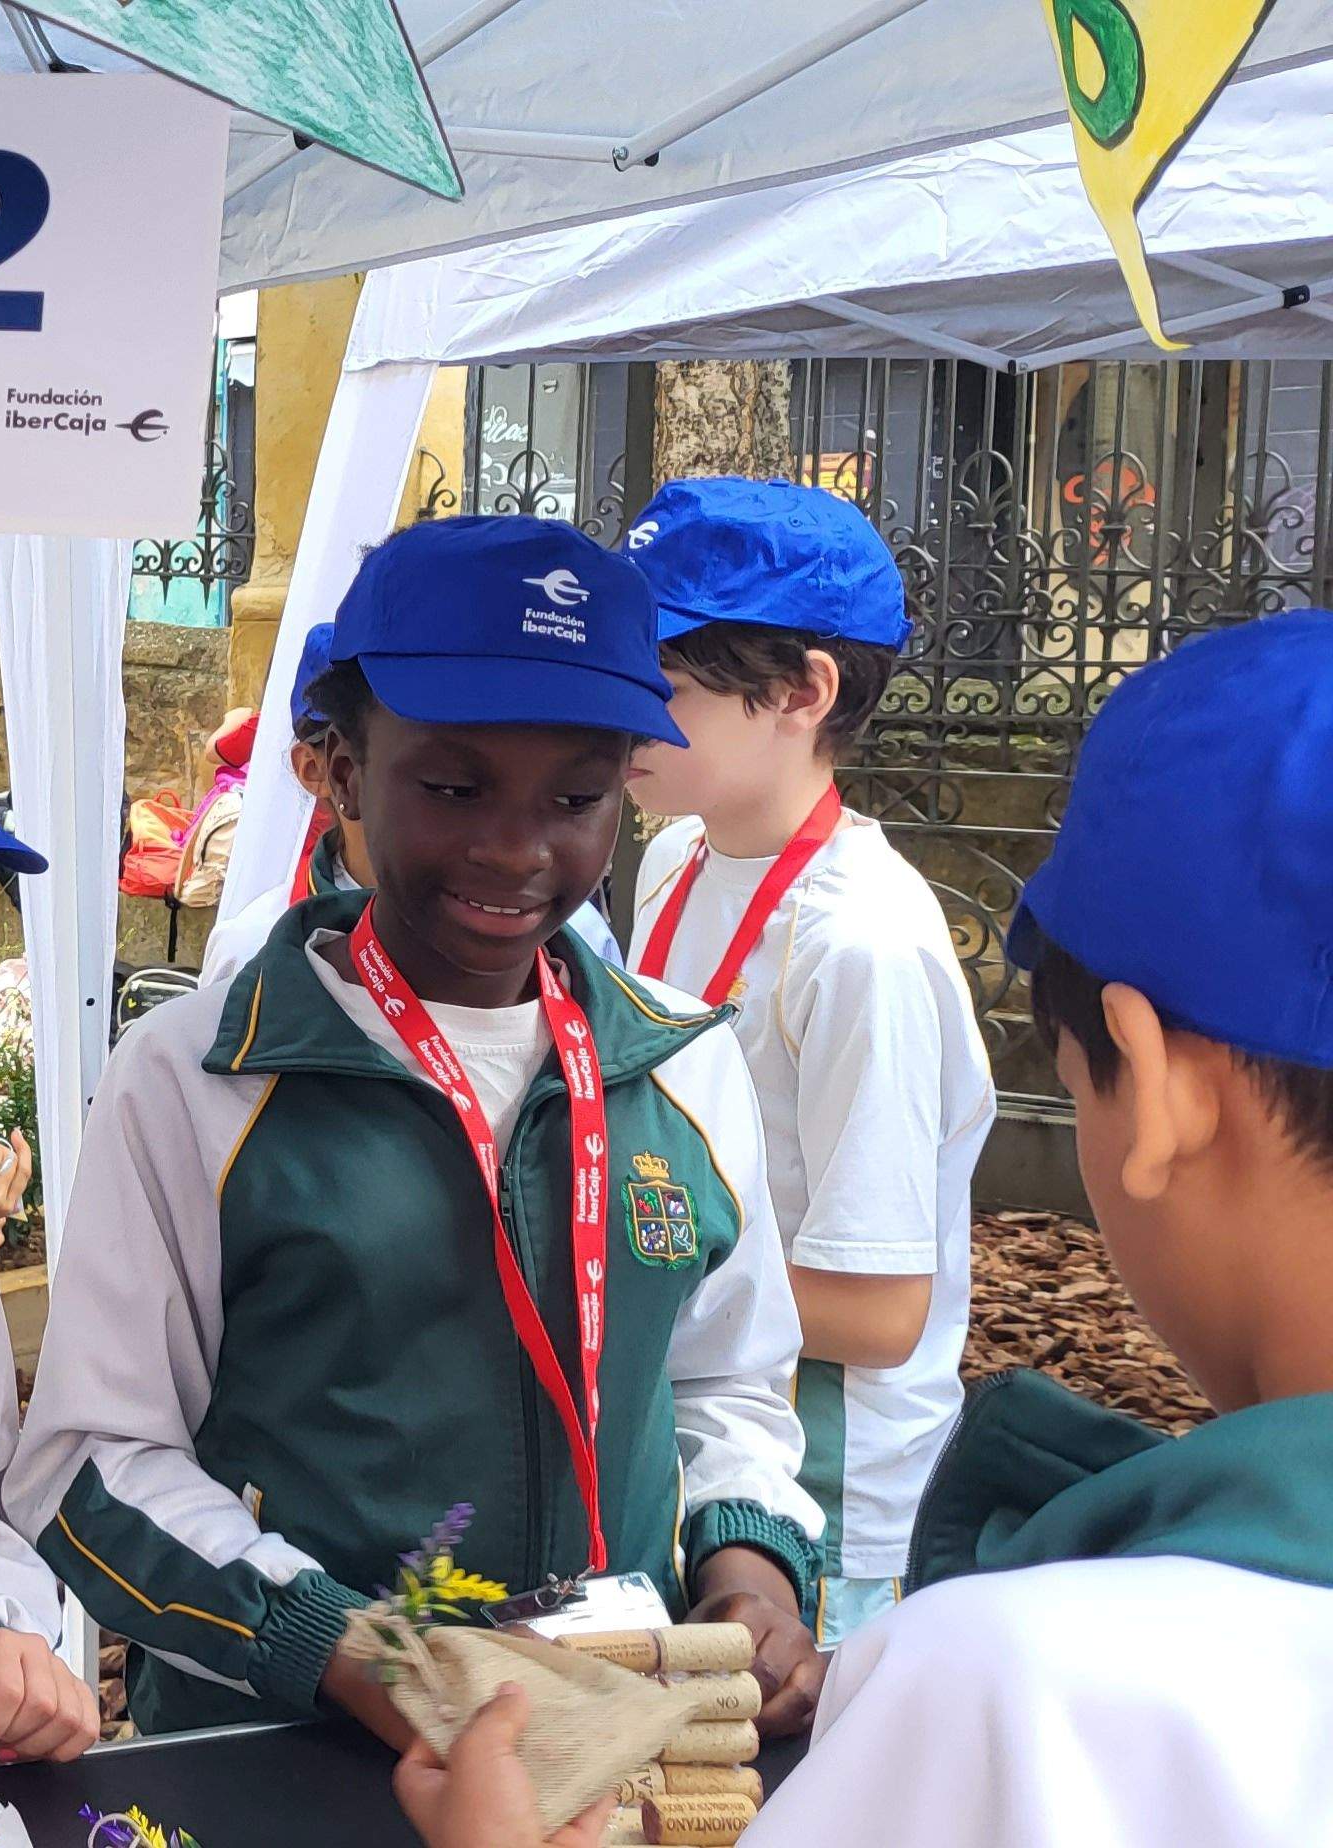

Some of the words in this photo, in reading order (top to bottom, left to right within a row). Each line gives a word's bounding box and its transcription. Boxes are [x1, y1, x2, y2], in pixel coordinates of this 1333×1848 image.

[6, 387, 103, 406] Fundación
[5, 409, 107, 436] iberCaja
[522, 620, 586, 643] iberCaja
[525, 607, 585, 628] Fundación
[359, 948, 385, 993] iberCaja
[367, 939, 394, 982] Fundación
[416, 1039, 452, 1086] iberCaja
[431, 1034, 462, 1082] Fundación
[565, 1048, 583, 1098] Fundación
[576, 1047, 596, 1100] iberCaja
[587, 1165, 602, 1225] iberCaja
